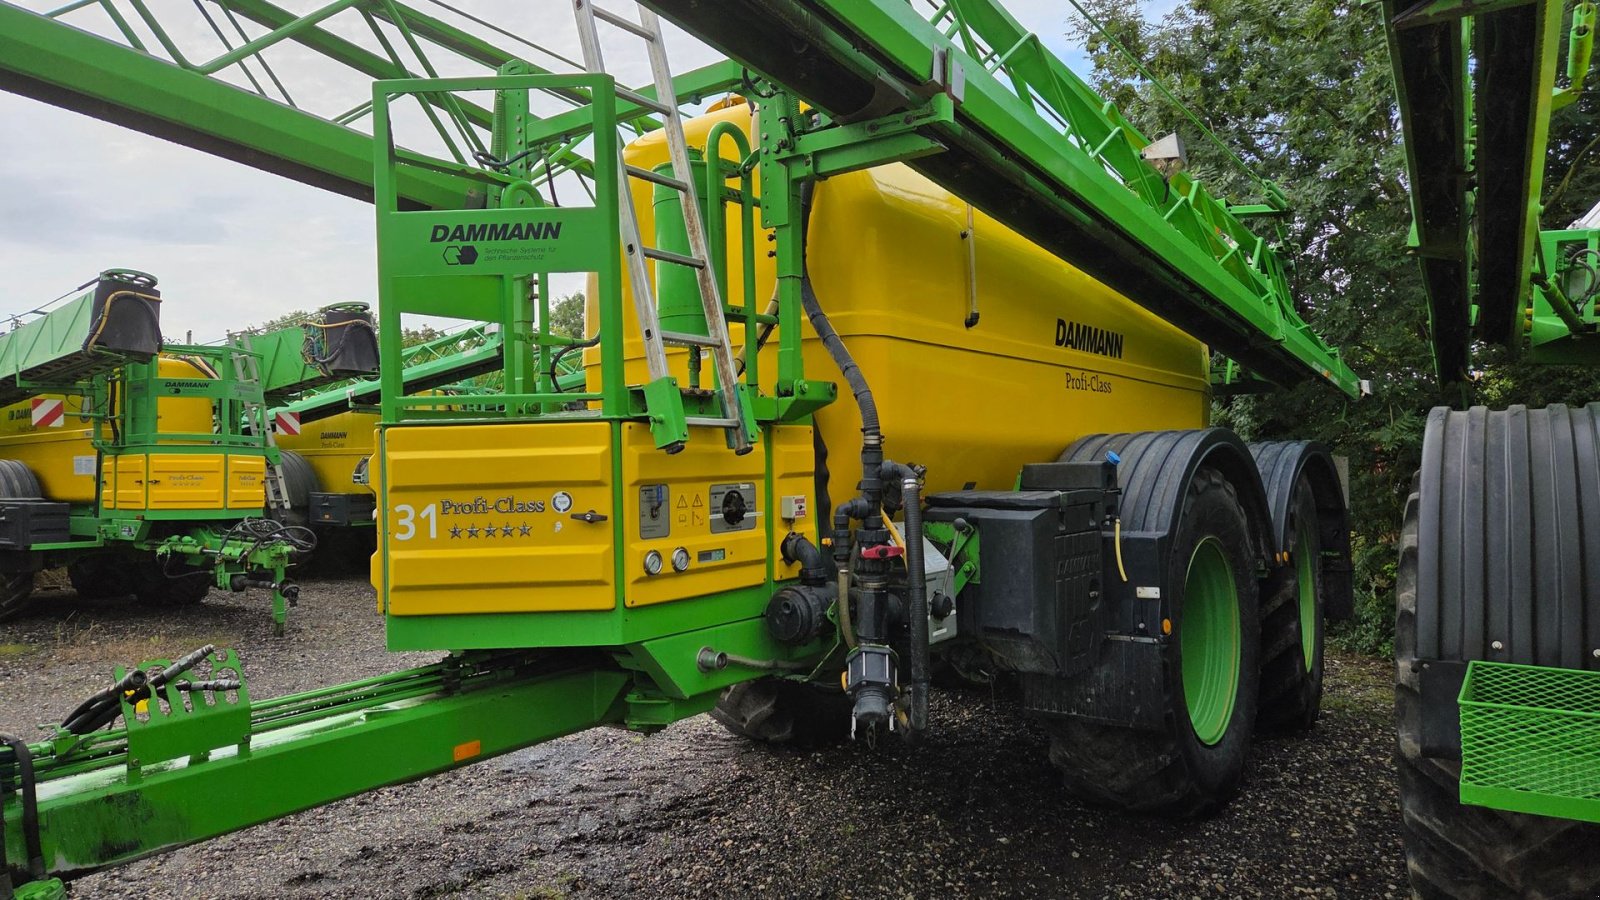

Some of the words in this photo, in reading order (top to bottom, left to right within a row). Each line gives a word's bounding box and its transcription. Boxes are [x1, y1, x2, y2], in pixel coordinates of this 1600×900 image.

[430, 222, 562, 243] DAMMANN
[485, 247, 517, 255] Technische
[520, 246, 545, 256] Systeme
[1055, 318, 1124, 359] DAMMANN
[1065, 372, 1112, 393] Profi-Class
[441, 496, 546, 515] Profi-Class
[394, 504, 437, 541] 31
